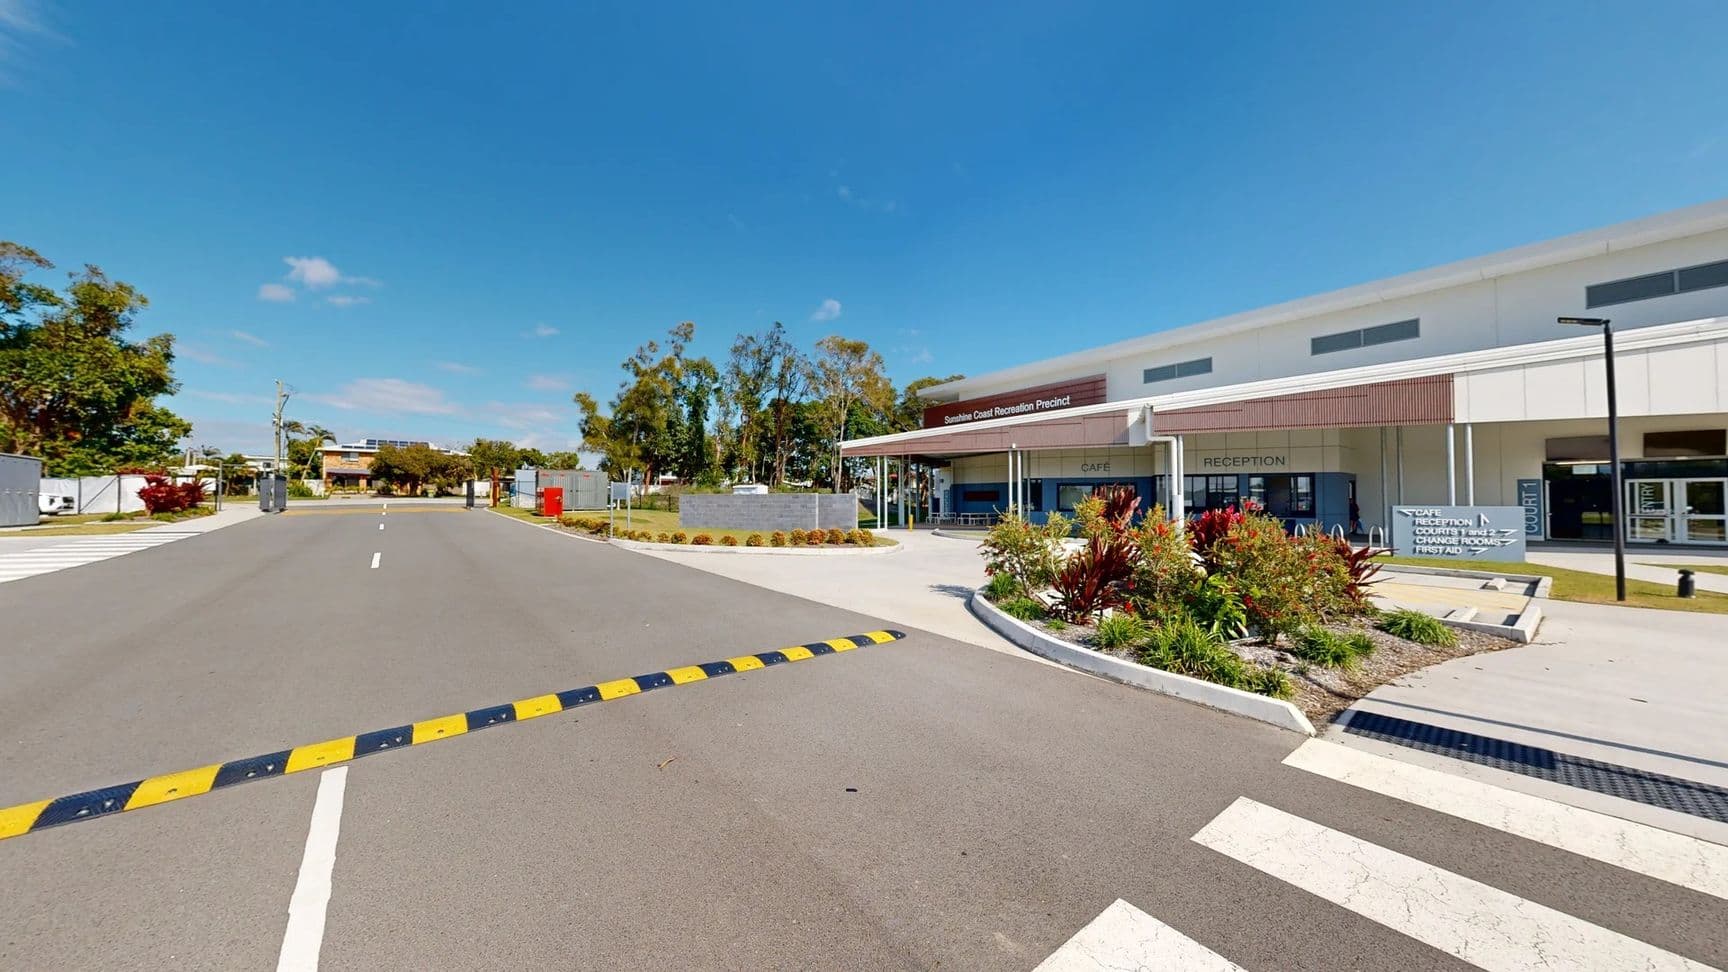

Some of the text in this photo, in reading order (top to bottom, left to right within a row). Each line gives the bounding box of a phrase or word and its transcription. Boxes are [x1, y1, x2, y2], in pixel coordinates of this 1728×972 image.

[944, 395, 1070, 424] Sunshine Coast Recreation Precinct
[1203, 456, 1286, 467] RECEPTION
[1641, 483, 1655, 513] ENTRY
[1522, 491, 1538, 533] COURT
[1415, 518, 1473, 526] RECEPTION
[1415, 527, 1458, 535] COURTS
[1415, 536, 1501, 546] CHANGE ROOMS
[1415, 546, 1444, 554] FIRST
